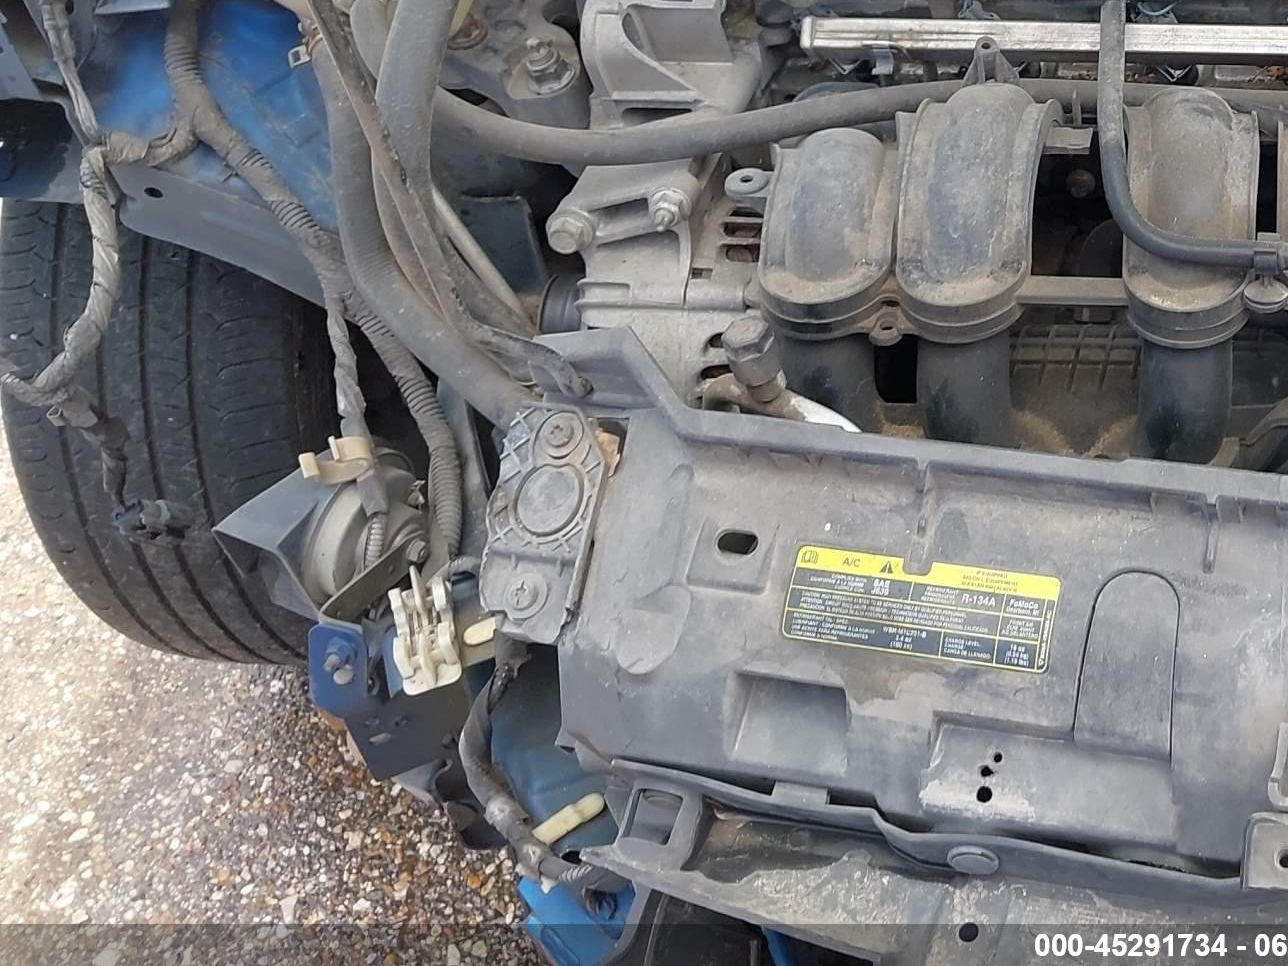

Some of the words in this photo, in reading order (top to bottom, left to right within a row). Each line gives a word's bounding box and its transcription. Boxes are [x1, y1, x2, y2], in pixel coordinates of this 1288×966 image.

[842, 557, 861, 567] A/C
[873, 578, 890, 588] SAE
[871, 586, 889, 596] J639
[961, 593, 996, 607] R-134A
[1009, 599, 1039, 610] FoMoCo
